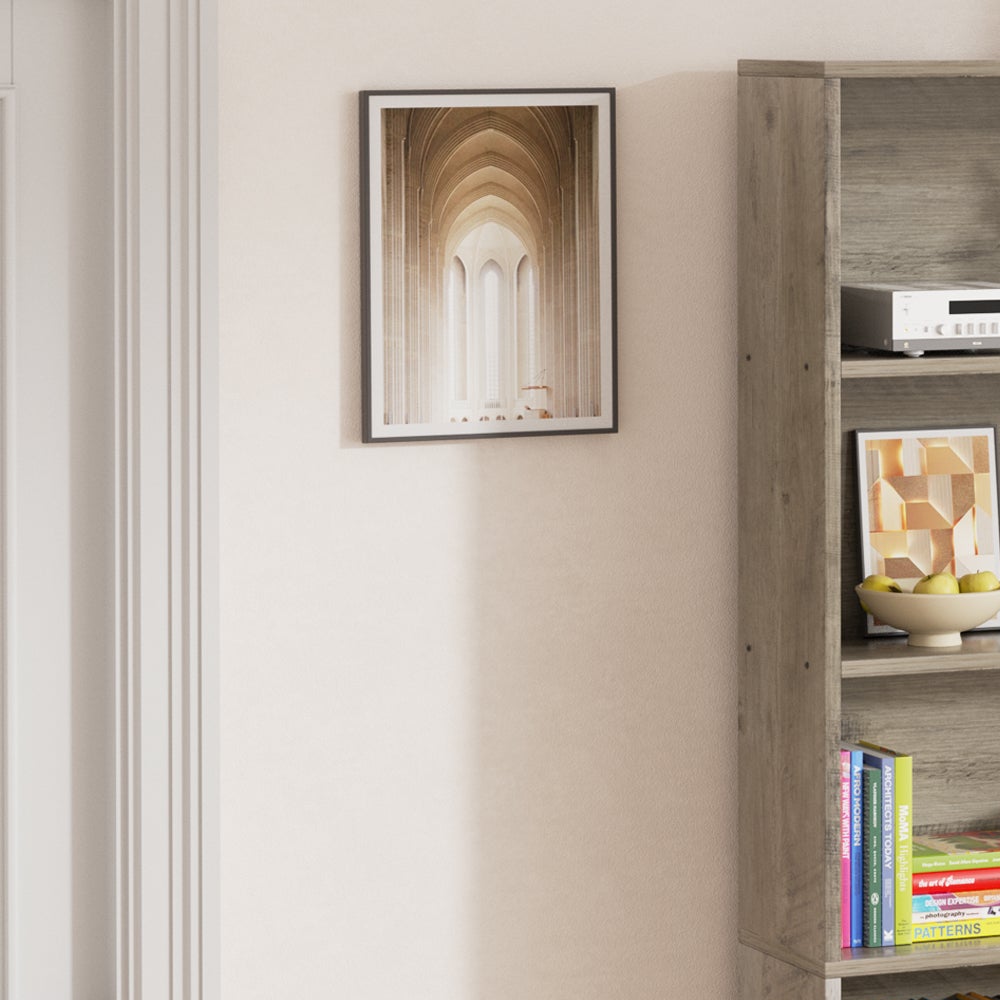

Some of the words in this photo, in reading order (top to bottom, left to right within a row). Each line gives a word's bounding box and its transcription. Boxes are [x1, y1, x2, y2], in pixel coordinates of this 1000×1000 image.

[853, 765, 862, 796] AFRO
[884, 765, 892, 832] ARCHITECTS
[854, 798, 862, 846] MODERN
[898, 804, 909, 842] MoMA
[884, 832, 892, 869] TODAY
[896, 845, 909, 892] Highlights
[918, 880, 928, 888] the
[928, 879, 938, 887] art
[914, 923, 982, 939] PATTERNS
[924, 911, 966, 920] photography
